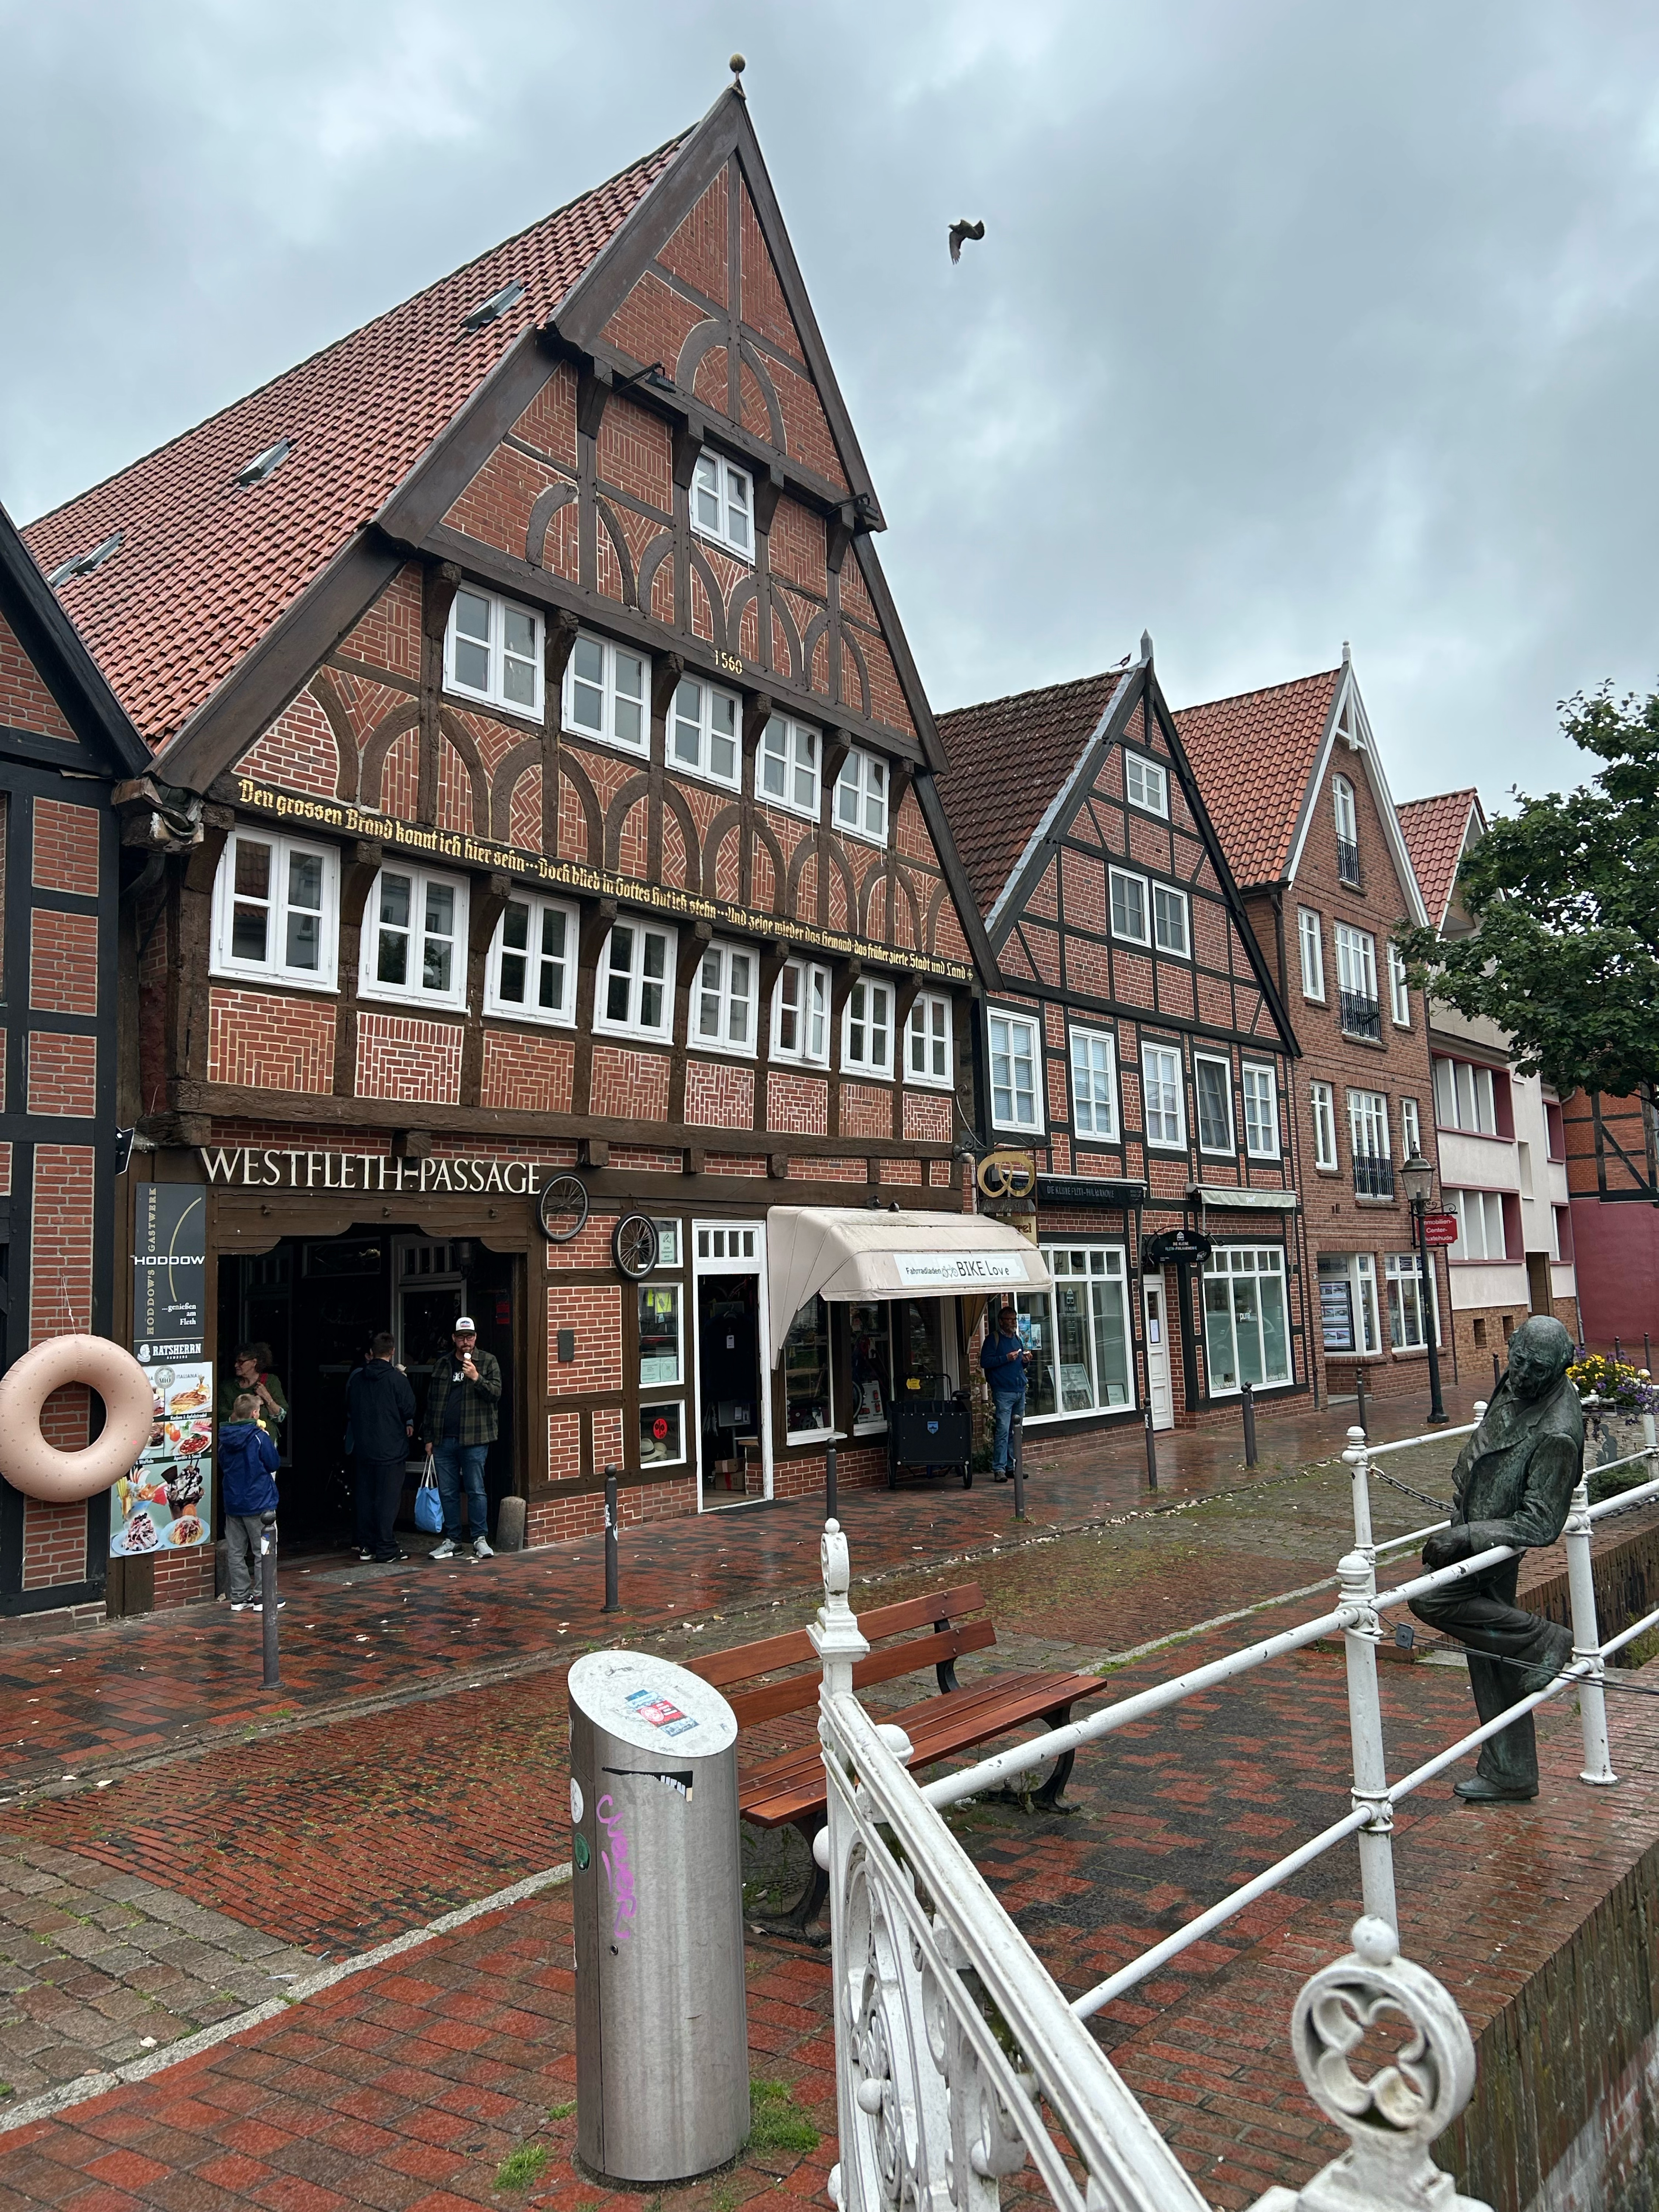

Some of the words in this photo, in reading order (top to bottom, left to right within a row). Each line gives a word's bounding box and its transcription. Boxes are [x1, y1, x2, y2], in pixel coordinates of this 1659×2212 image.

[238, 778, 273, 808] Den
[276, 795, 342, 826] grossen
[345, 808, 393, 839] Brand
[396, 820, 437, 851] konnt
[439, 832, 460, 857] ich
[464, 838, 492, 865] hier
[571, 865, 600, 890] blieb
[602, 874, 614, 894] in
[615, 877, 650, 902] Gottes
[672, 892, 688, 911] ich
[748, 915, 773, 934] zeige
[774, 922, 804, 940] wieder
[805, 926, 821, 945] das
[867, 945, 888, 962] früher
[888, 950, 908, 966] zierte
[909, 954, 930, 971] Stadt
[931, 962, 945, 974] und
[946, 962, 966, 979] Land
[200, 1147, 541, 1194] WESTFLETH-PASSAGE
[148, 1187, 157, 1252] GASTWERK
[135, 1255, 205, 1266] HODDOW
[906, 1267, 942, 1275] Fahrradladen
[956, 1261, 986, 1276] BIKE
[985, 1260, 1009, 1276] Love
[153, 1343, 201, 1356] RATSHERRN
